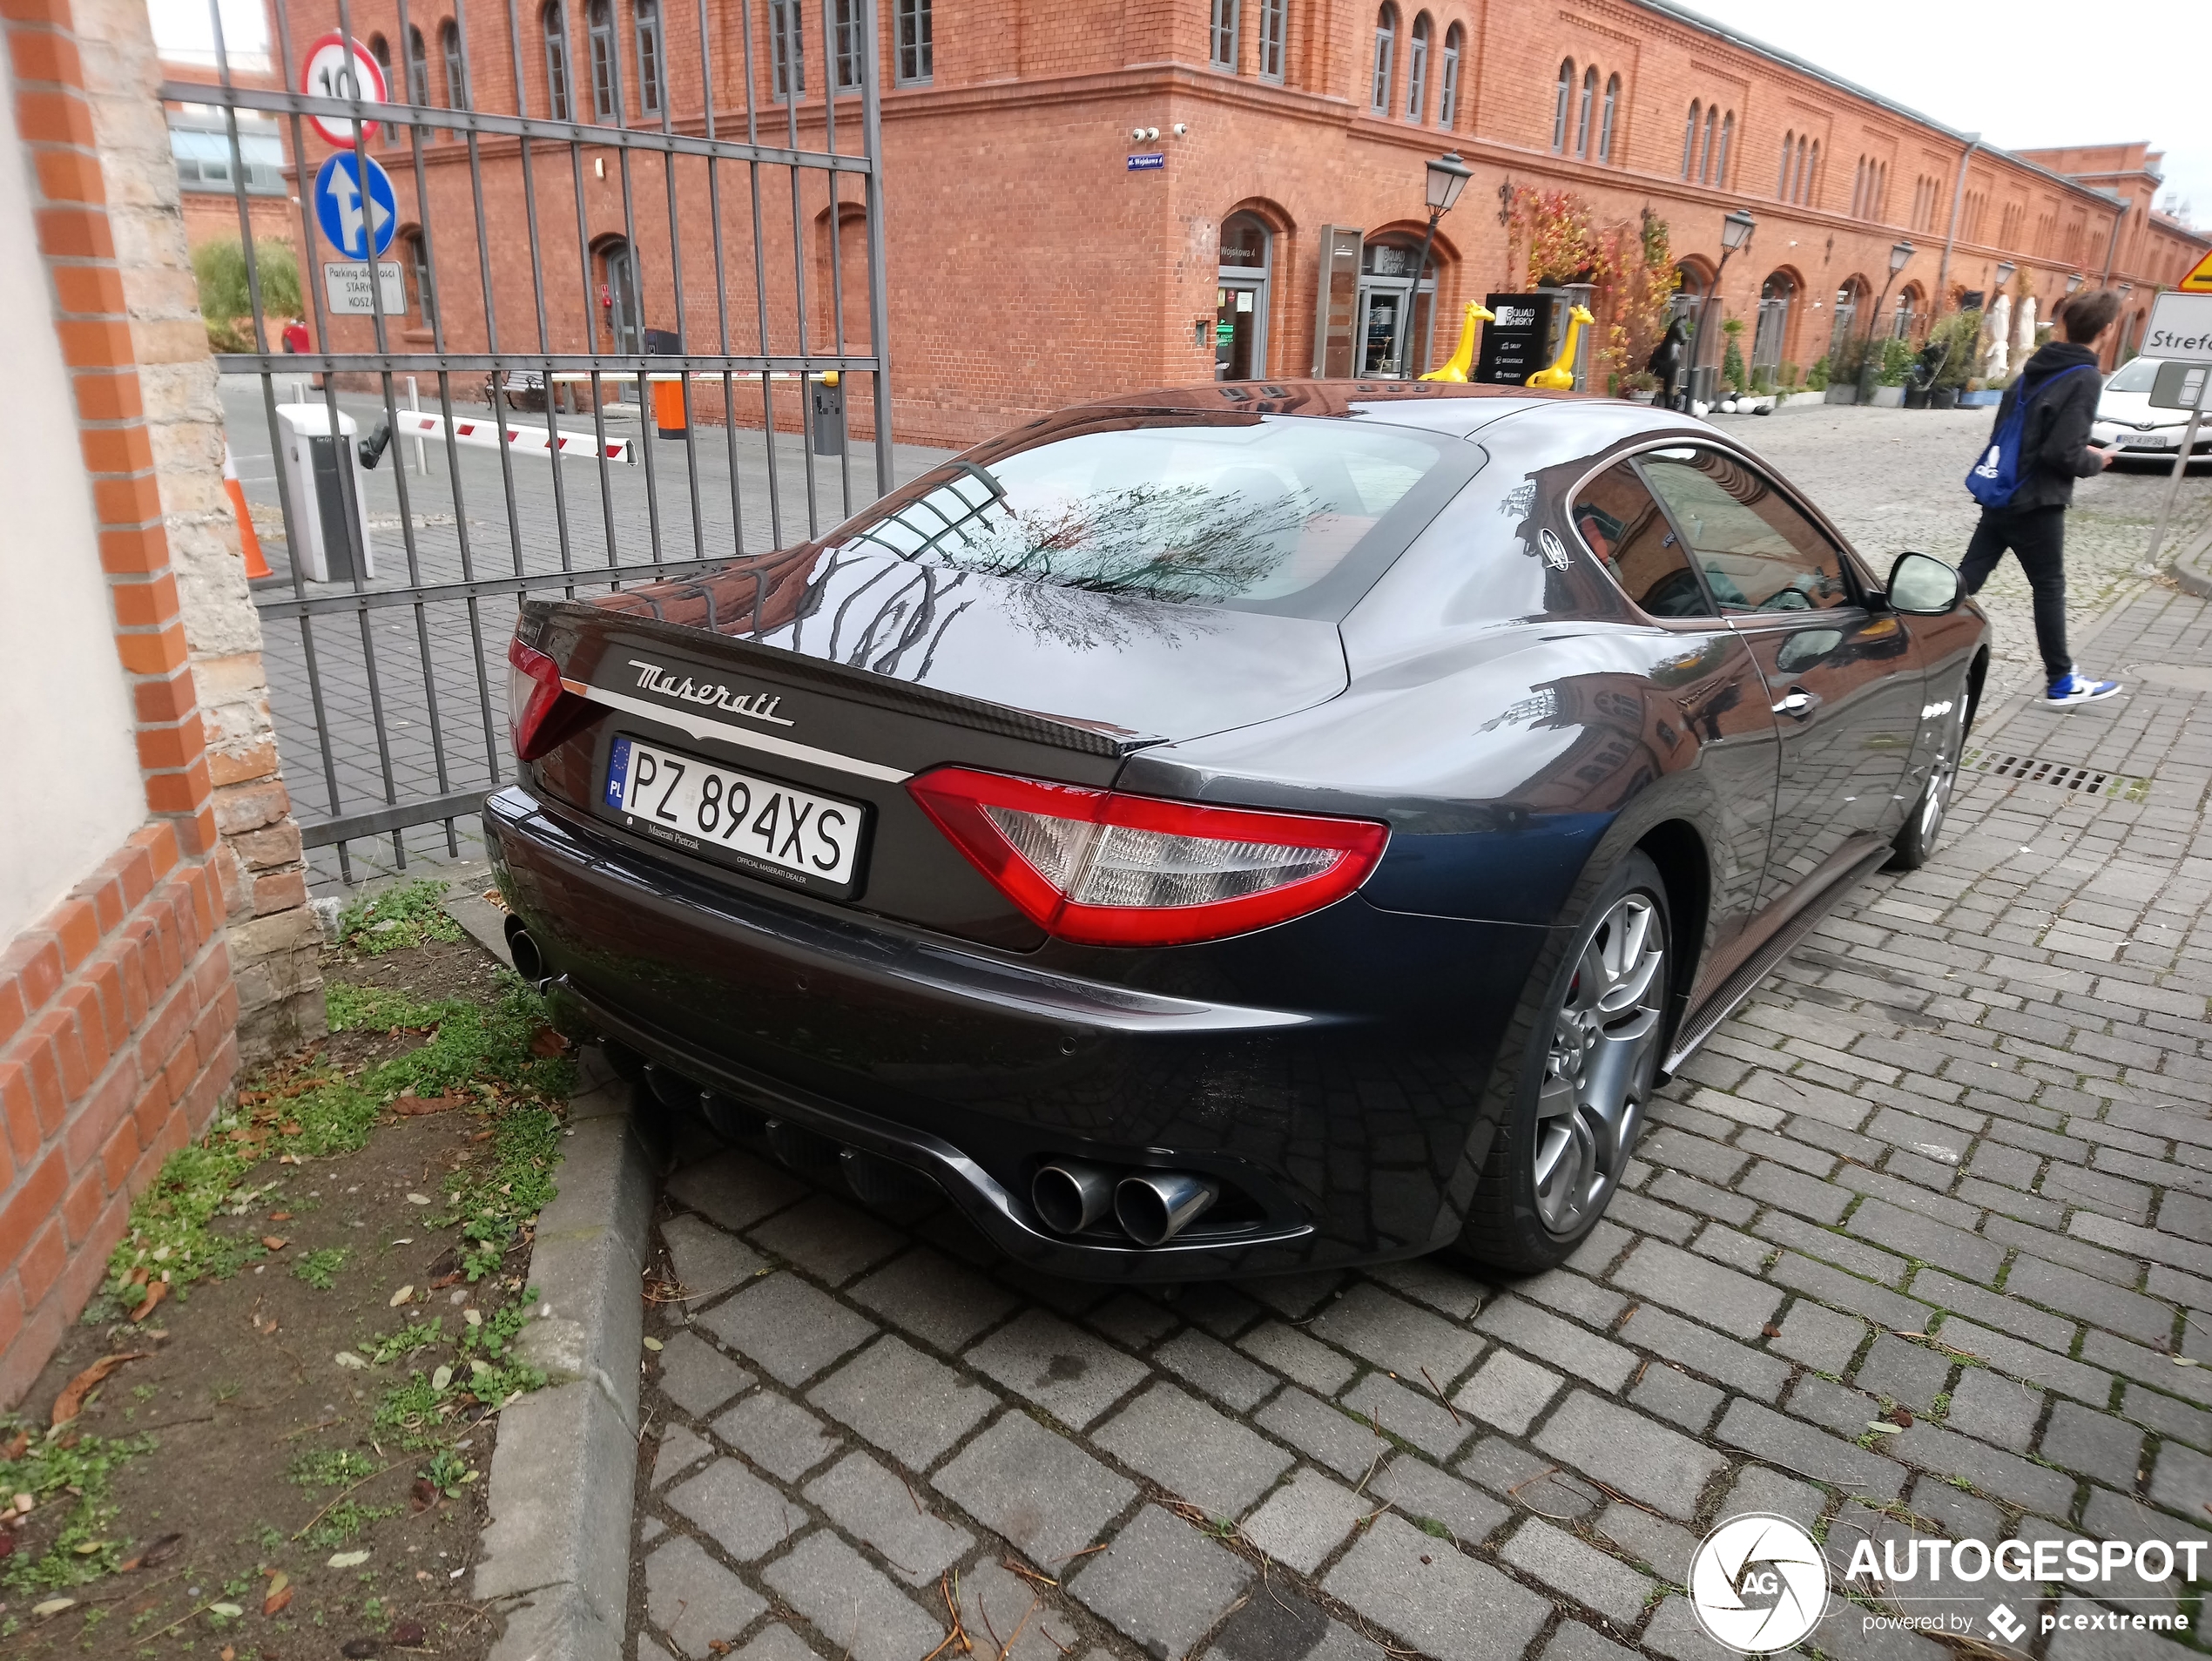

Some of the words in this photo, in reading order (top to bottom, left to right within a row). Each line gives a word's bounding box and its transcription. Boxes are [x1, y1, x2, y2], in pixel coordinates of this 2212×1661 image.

[1221, 246, 1251, 258] Wojskowa
[1251, 247, 1256, 257] 4
[329, 267, 357, 280] Parking
[348, 296, 376, 307] KOSZA
[1507, 307, 1535, 317] SQUAD
[1506, 317, 1534, 326] WHISKY
[628, 659, 795, 726] Maserati
[610, 780, 622, 799] PL
[631, 751, 686, 822] PZ
[698, 774, 846, 871] 894XS
[648, 824, 674, 841] Maserati
[674, 833, 700, 851] Pietrzak
[737, 855, 759, 870] OFFICIAL
[759, 862, 786, 877] MASERATI
[786, 871, 807, 885] DEALER
